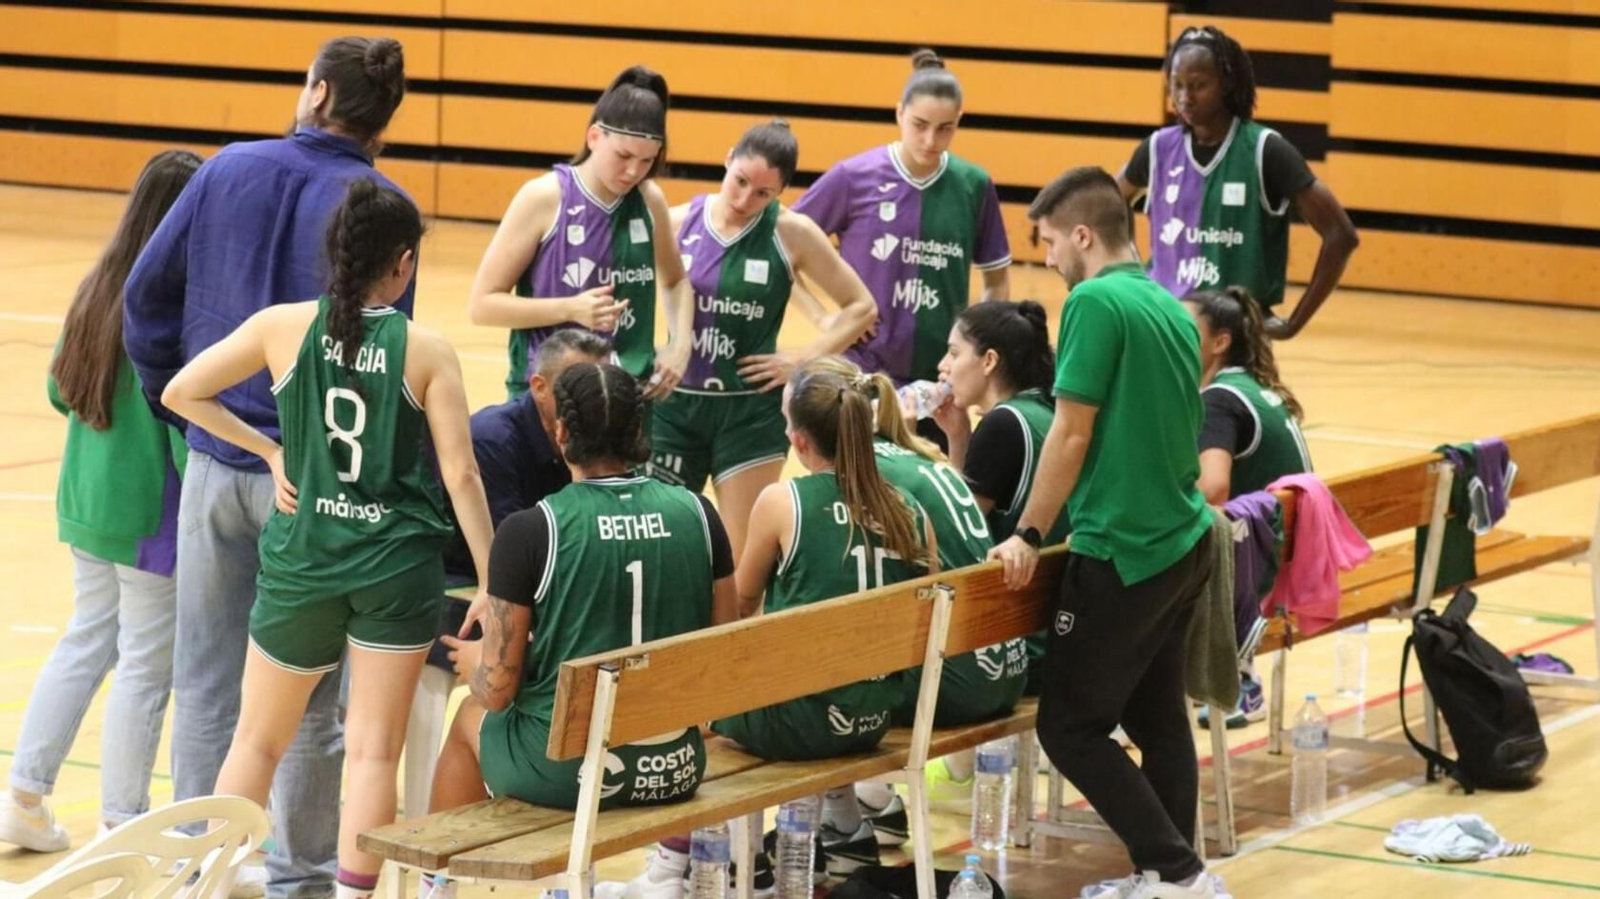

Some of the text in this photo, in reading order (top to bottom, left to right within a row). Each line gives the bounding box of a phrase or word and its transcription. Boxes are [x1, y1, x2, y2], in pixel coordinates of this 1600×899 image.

[902, 237, 964, 258] Fundación
[1186, 227, 1244, 248] Unicaja
[598, 263, 654, 286] Unicaja
[902, 251, 948, 270] Unicaja
[1177, 256, 1220, 289] Mijas
[698, 295, 765, 321] Unicaja
[892, 278, 940, 314] Mijas
[321, 335, 386, 374] GACÍA
[325, 387, 366, 482] 8
[918, 462, 989, 541] 19
[597, 512, 672, 541] BETHEL
[625, 560, 643, 647] 1
[636, 743, 696, 773] COSTA
[630, 775, 698, 801] MÁLAGA
[635, 761, 697, 789] DEL SOL
